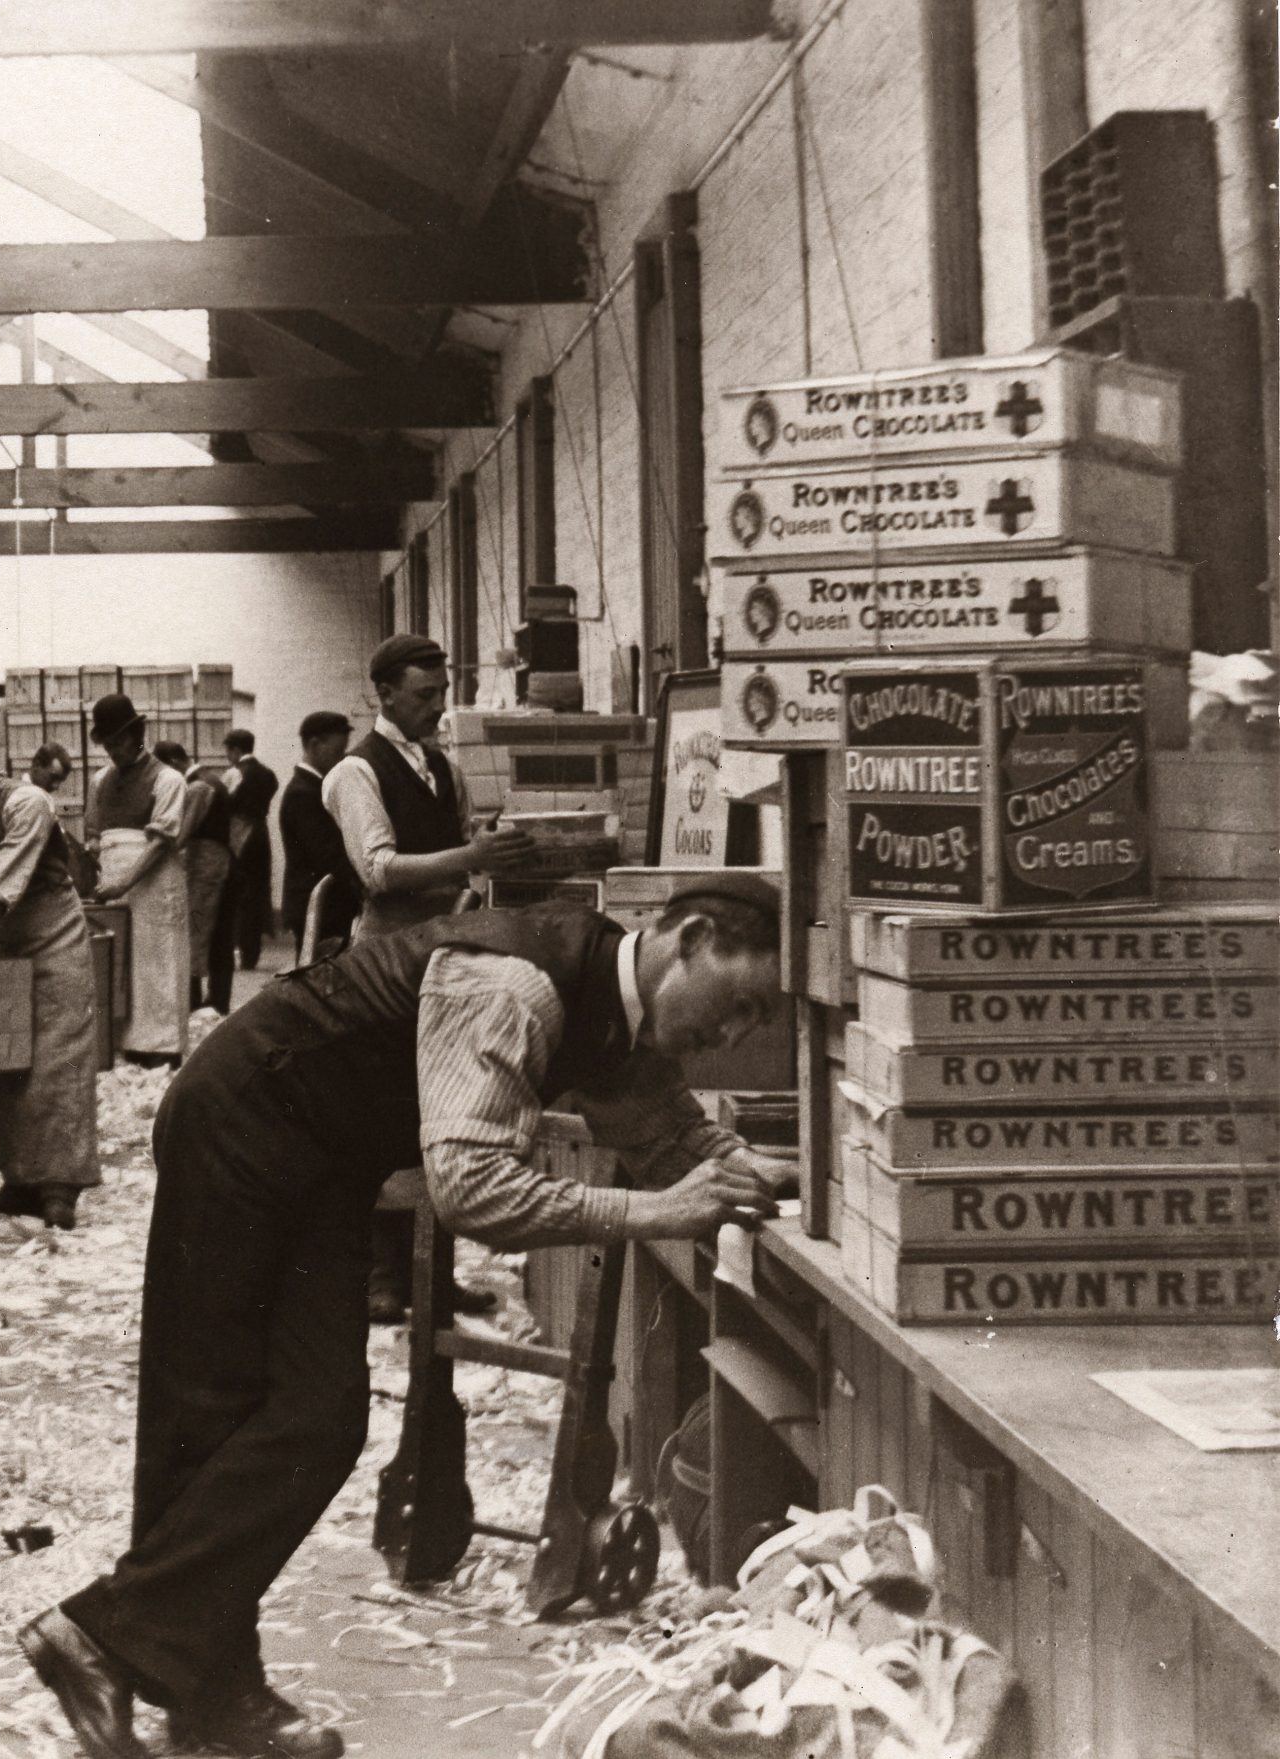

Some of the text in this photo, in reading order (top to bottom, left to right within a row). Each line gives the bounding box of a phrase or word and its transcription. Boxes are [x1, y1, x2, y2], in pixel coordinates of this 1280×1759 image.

[805, 378, 969, 415] ROWNTREE'S
[782, 410, 987, 448] Queen CHOCOLATE
[792, 473, 959, 508] ROWNTREE'S
[769, 514, 832, 541] Queen
[840, 507, 977, 534] CHOCOLATE
[808, 571, 982, 604] ROWNTREE'S
[785, 605, 1000, 636] Queen CHOCOLATE
[849, 683, 978, 733] CHOCOLATE
[845, 750, 982, 793] ROWNTREE
[1007, 738, 1140, 827] Chocolates
[857, 813, 974, 873] POWDER
[1016, 835, 1135, 870] Creams
[940, 928, 1244, 961] ROWNTREE'S
[949, 990, 1255, 1023] ROWNTREE'S
[941, 1052, 1248, 1086] ROWNTREE'S
[931, 1117, 1238, 1150] ROWNTREE'S
